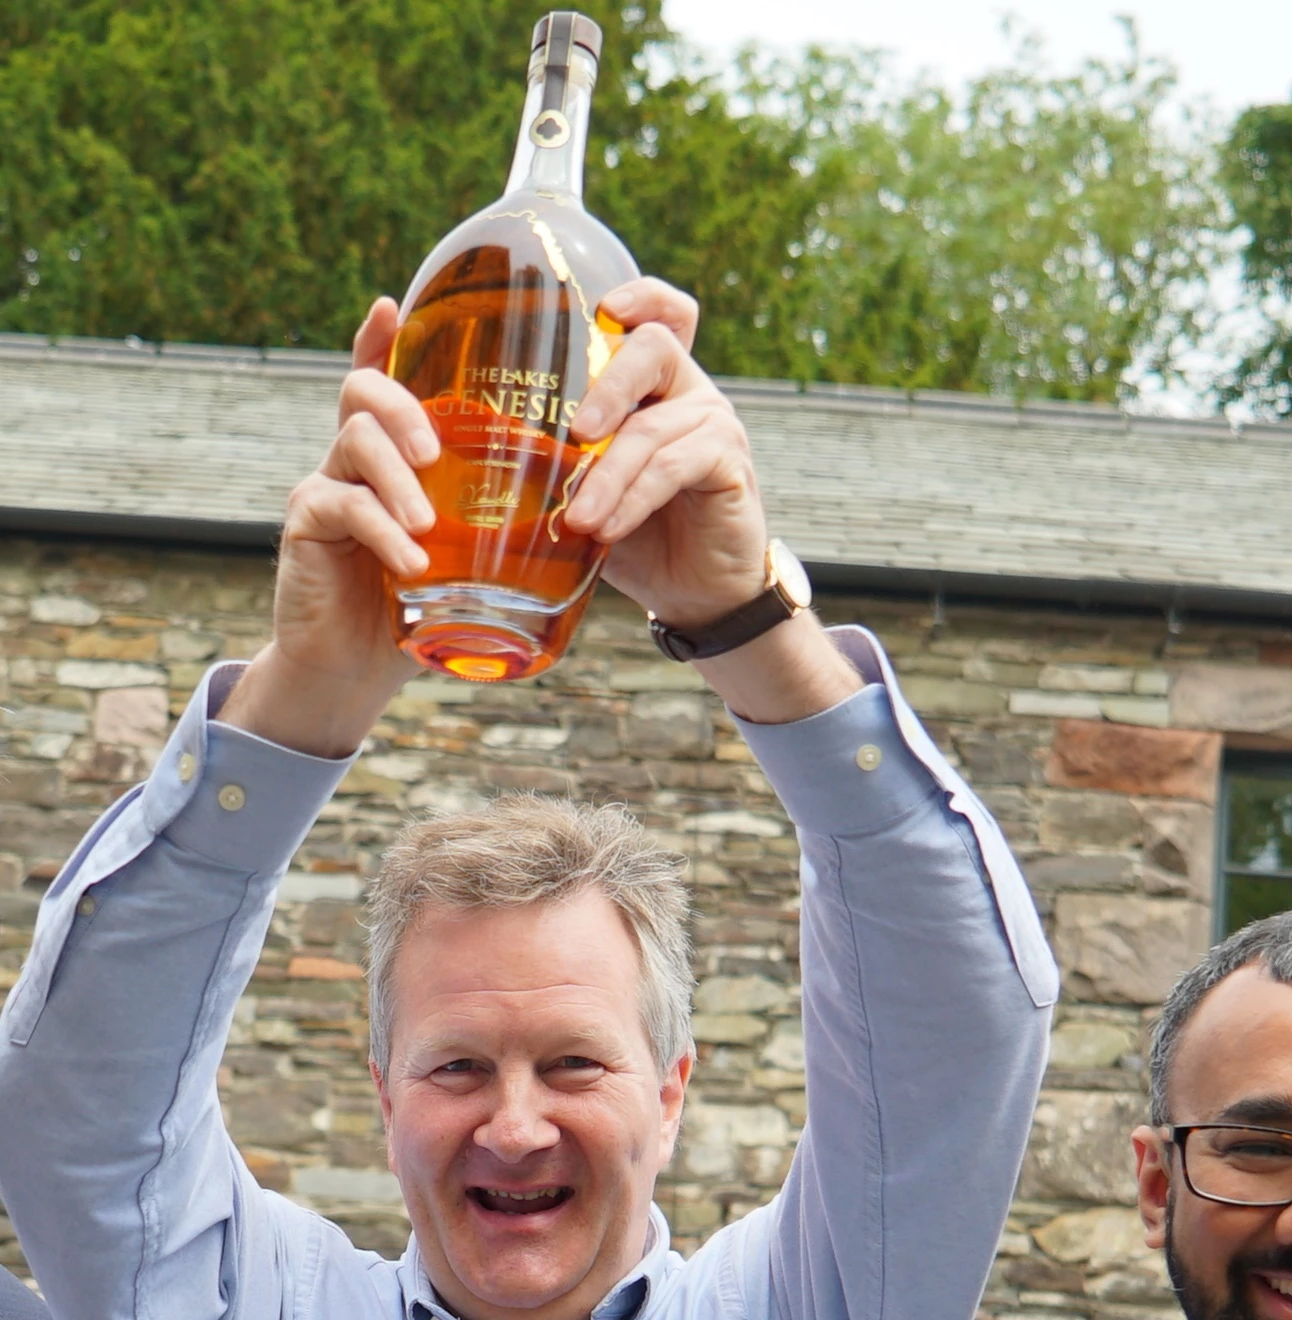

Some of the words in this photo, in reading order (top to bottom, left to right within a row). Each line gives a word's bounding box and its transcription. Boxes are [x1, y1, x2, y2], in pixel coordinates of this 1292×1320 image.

[463, 367, 499, 384] THE
[501, 368, 560, 390] LAKES
[432, 388, 580, 428] GENESIS
